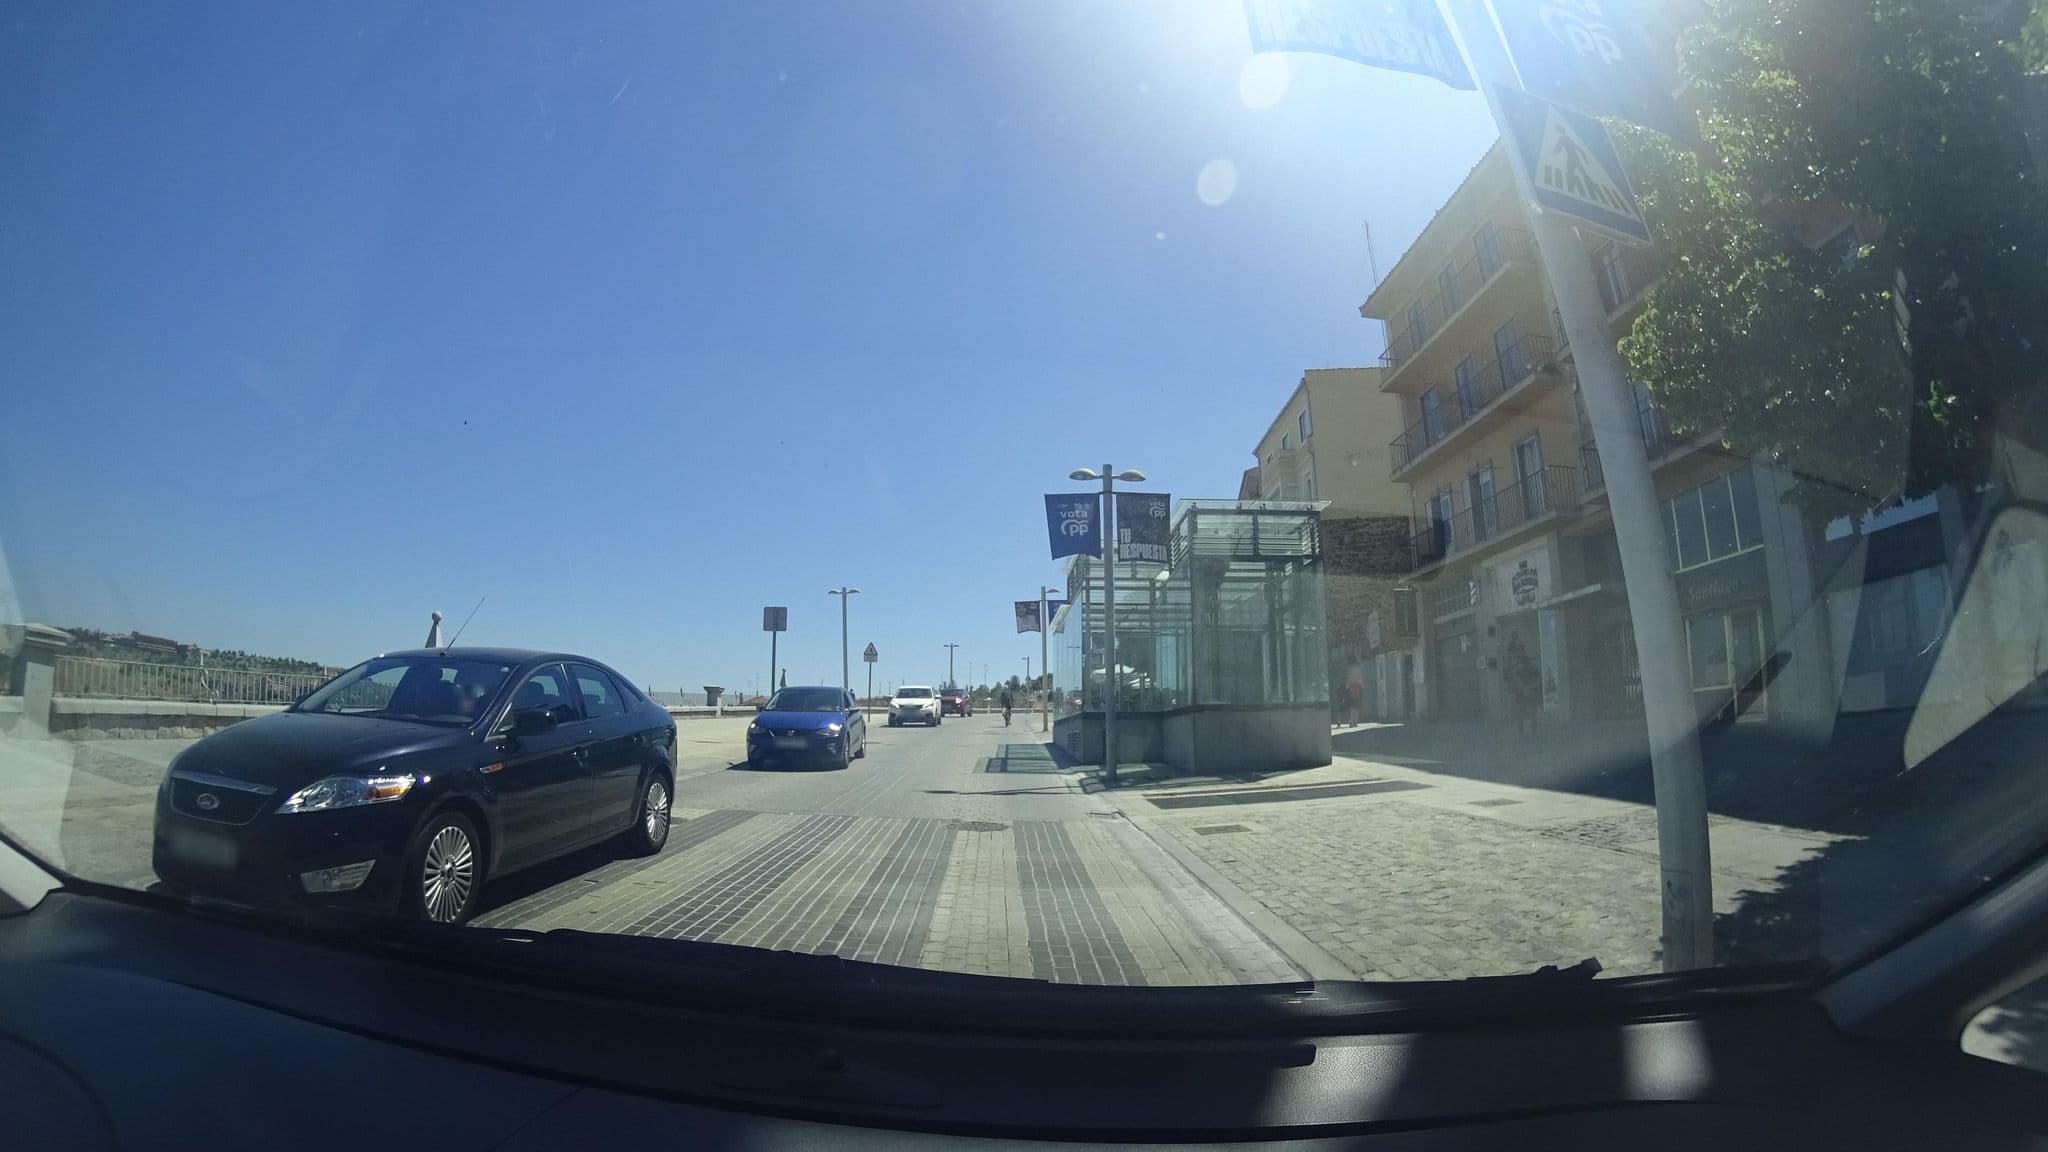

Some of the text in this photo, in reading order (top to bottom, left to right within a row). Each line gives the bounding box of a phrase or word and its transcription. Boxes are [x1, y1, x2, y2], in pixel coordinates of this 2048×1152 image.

[1060, 510, 1088, 519] vota
[1119, 528, 1131, 543] TU
[1120, 543, 1168, 561] RESPUESTA
